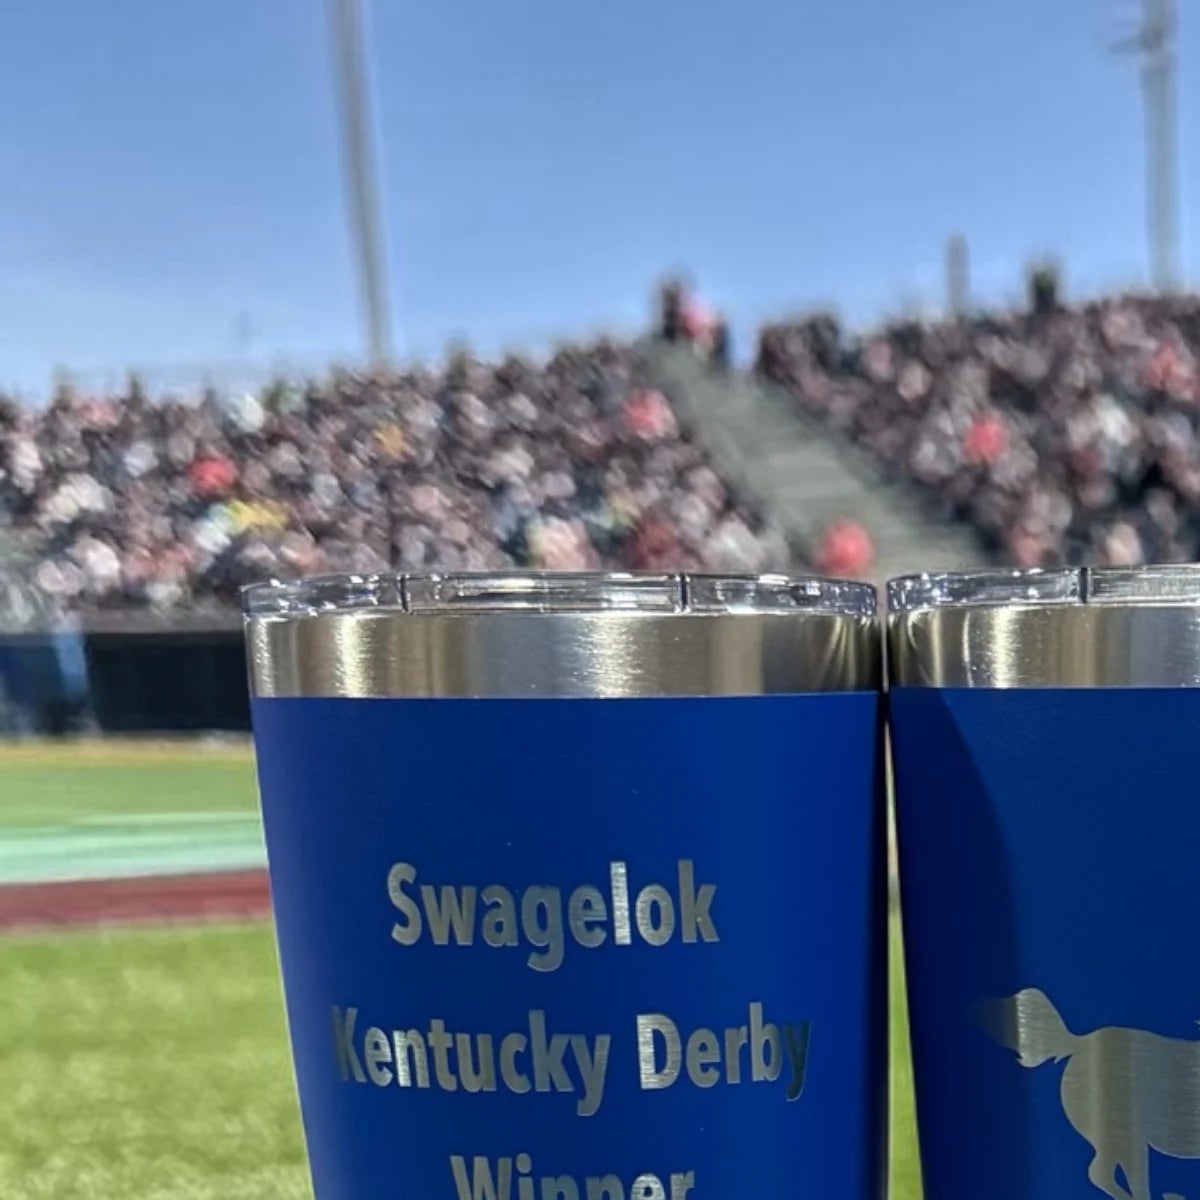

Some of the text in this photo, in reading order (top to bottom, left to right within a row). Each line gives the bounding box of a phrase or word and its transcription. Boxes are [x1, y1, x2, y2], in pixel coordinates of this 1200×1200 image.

[386, 859, 719, 972] Swagelok
[333, 1001, 811, 1116] Kentucky Derby
